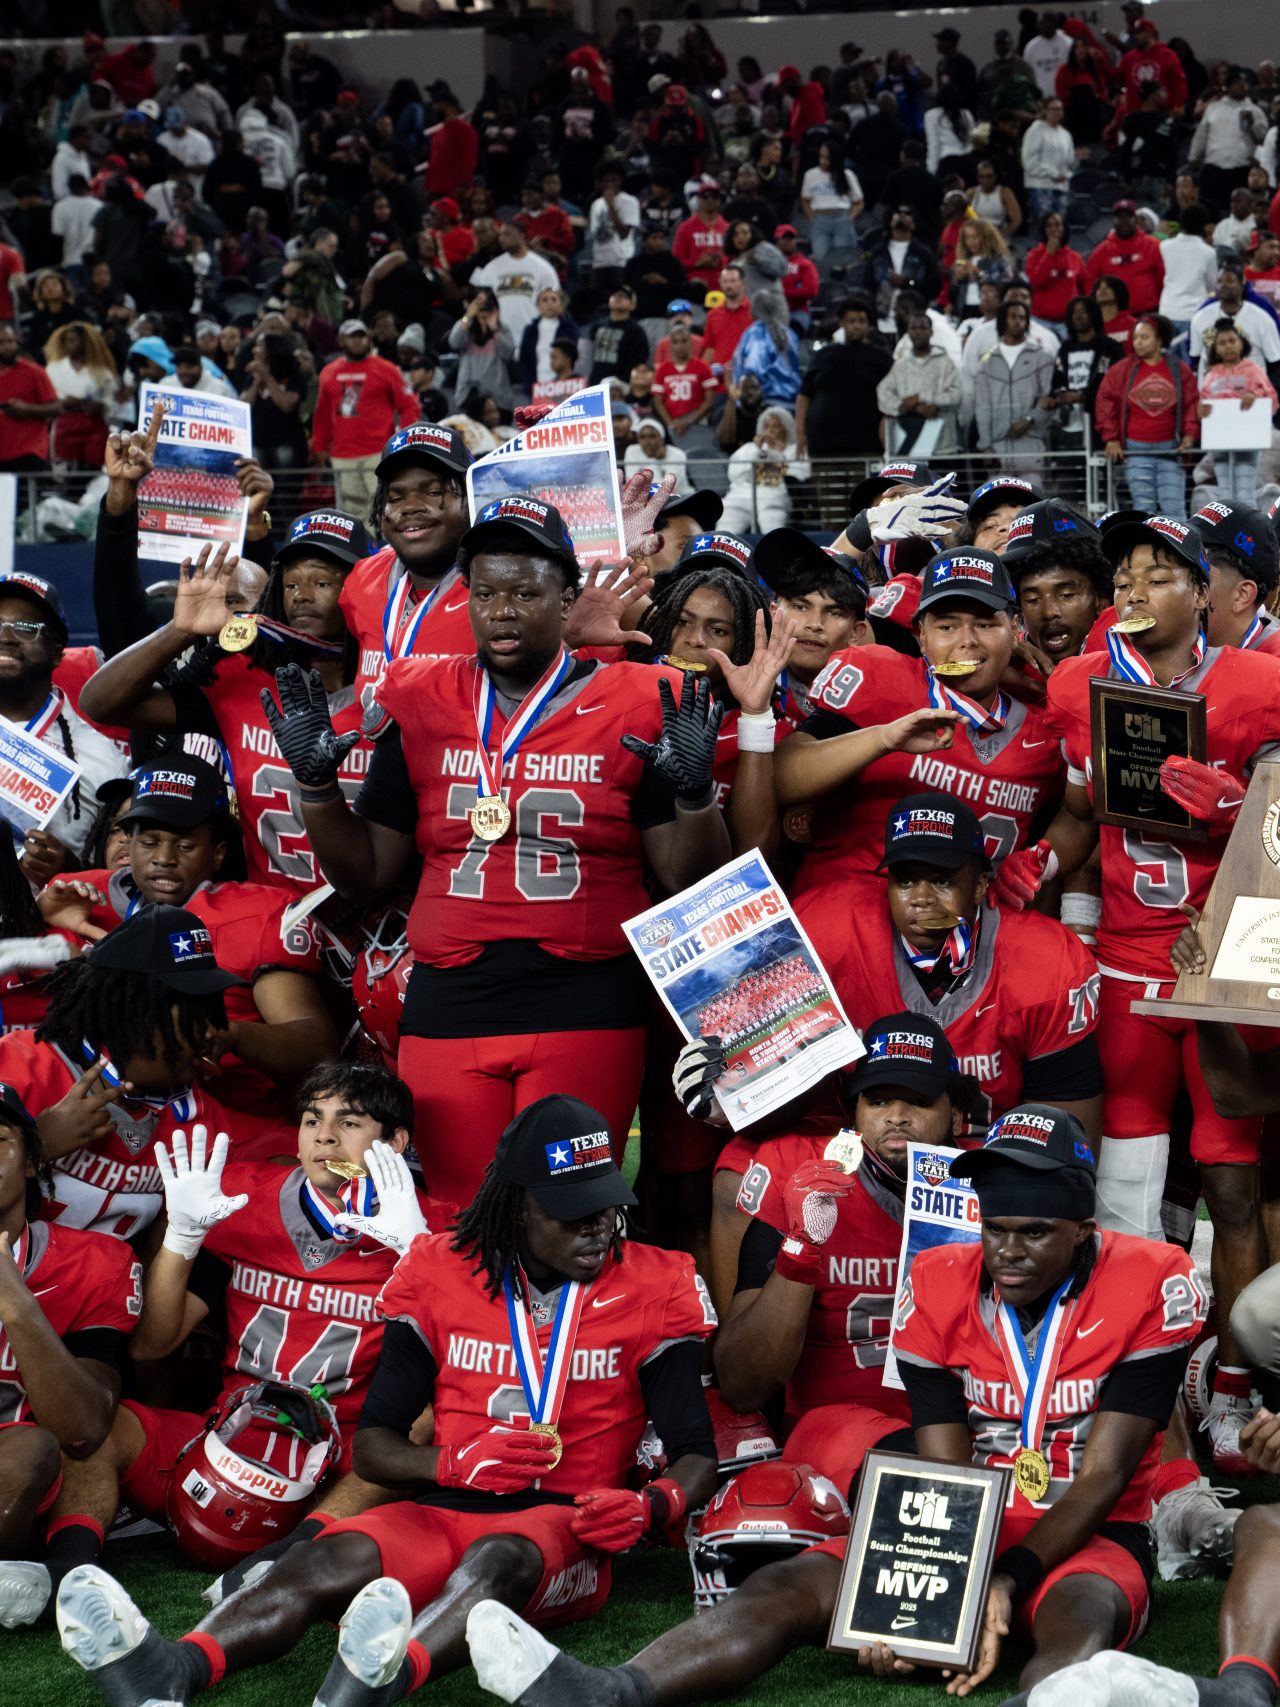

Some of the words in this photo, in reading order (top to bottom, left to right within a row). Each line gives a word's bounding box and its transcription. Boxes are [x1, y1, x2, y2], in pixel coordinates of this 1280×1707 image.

[534, 379, 585, 398] NORTH
[669, 381, 692, 400] 30
[143, 416, 186, 438] SATE
[407, 427, 453, 442] TEXAS
[526, 421, 608, 450] CHAMPS!
[406, 435, 451, 449] STRONG
[992, 477, 1033, 491] TEXAS
[497, 506, 545, 523] STRONG
[500, 498, 548, 517] TEXAS
[307, 522, 352, 540] STRONG
[310, 514, 355, 531] TEXAS
[710, 542, 749, 567] STRONG
[713, 535, 751, 557] TEXAS
[951, 556, 994, 571] TEXAS
[950, 567, 993, 582] STRONG
[808, 658, 864, 710] 49
[1124, 711, 1167, 742] UIL
[1108, 748, 1127, 758] State
[1132, 743, 1161, 754] Football
[152, 771, 196, 786] TEXAS
[525, 754, 604, 784] SHORE
[149, 782, 193, 796] STRONG
[908, 754, 988, 802] NORTH
[986, 779, 1040, 813] SHORE
[478, 806, 503, 825] UIL
[909, 809, 955, 825] TEXAS
[908, 821, 953, 837] STRONG
[1261, 810, 1280, 865] UNIVERSITY
[446, 783, 584, 900] 76
[682, 901, 711, 927] TEXAS
[708, 882, 749, 913] FOOTBALL
[649, 937, 705, 980] STATE
[701, 889, 786, 949] CHAMPS!
[1235, 915, 1268, 948] UNIVERSITY
[1261, 937, 1280, 945] STATE
[887, 1032, 934, 1048] TEXAS
[886, 1044, 932, 1059] STRONG
[1003, 1114, 1056, 1132] TEXAS
[570, 1131, 609, 1151] TEXAS
[998, 1125, 1053, 1142] STRONG
[574, 1145, 611, 1164] STRONG
[917, 1162, 949, 1178] STATE
[911, 1187, 963, 1219] STATE
[230, 1260, 303, 1311] NORTH
[307, 1284, 384, 1322] SHORE
[235, 1304, 363, 1394] 44
[217, 1454, 288, 1499] Riddell
[1019, 1461, 1042, 1486] UIL
[898, 1487, 953, 1530] UIL
[902, 1532, 940, 1546] Football
[870, 1540, 893, 1552] State
[895, 1543, 969, 1563] Championships
[893, 1560, 939, 1575] DEFENSE
[876, 1568, 949, 1601] MVP
